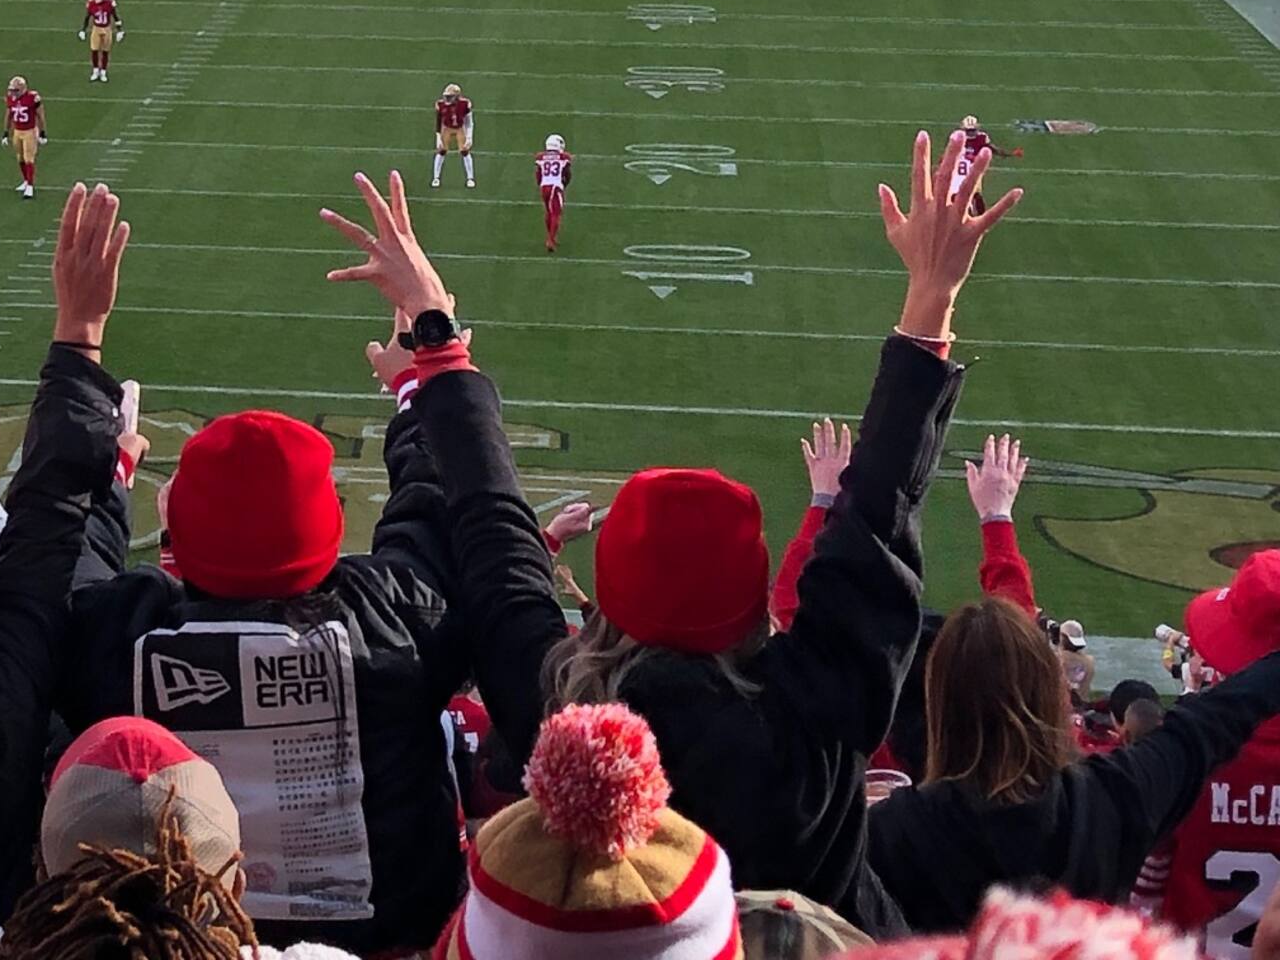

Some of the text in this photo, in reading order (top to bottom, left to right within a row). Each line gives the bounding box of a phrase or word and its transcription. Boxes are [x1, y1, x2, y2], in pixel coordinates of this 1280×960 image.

[11, 106, 29, 122] 75
[623, 143, 739, 176] 20
[621, 244, 753, 286] 10
[254, 651, 328, 683] NEW
[256, 680, 330, 709] ERA
